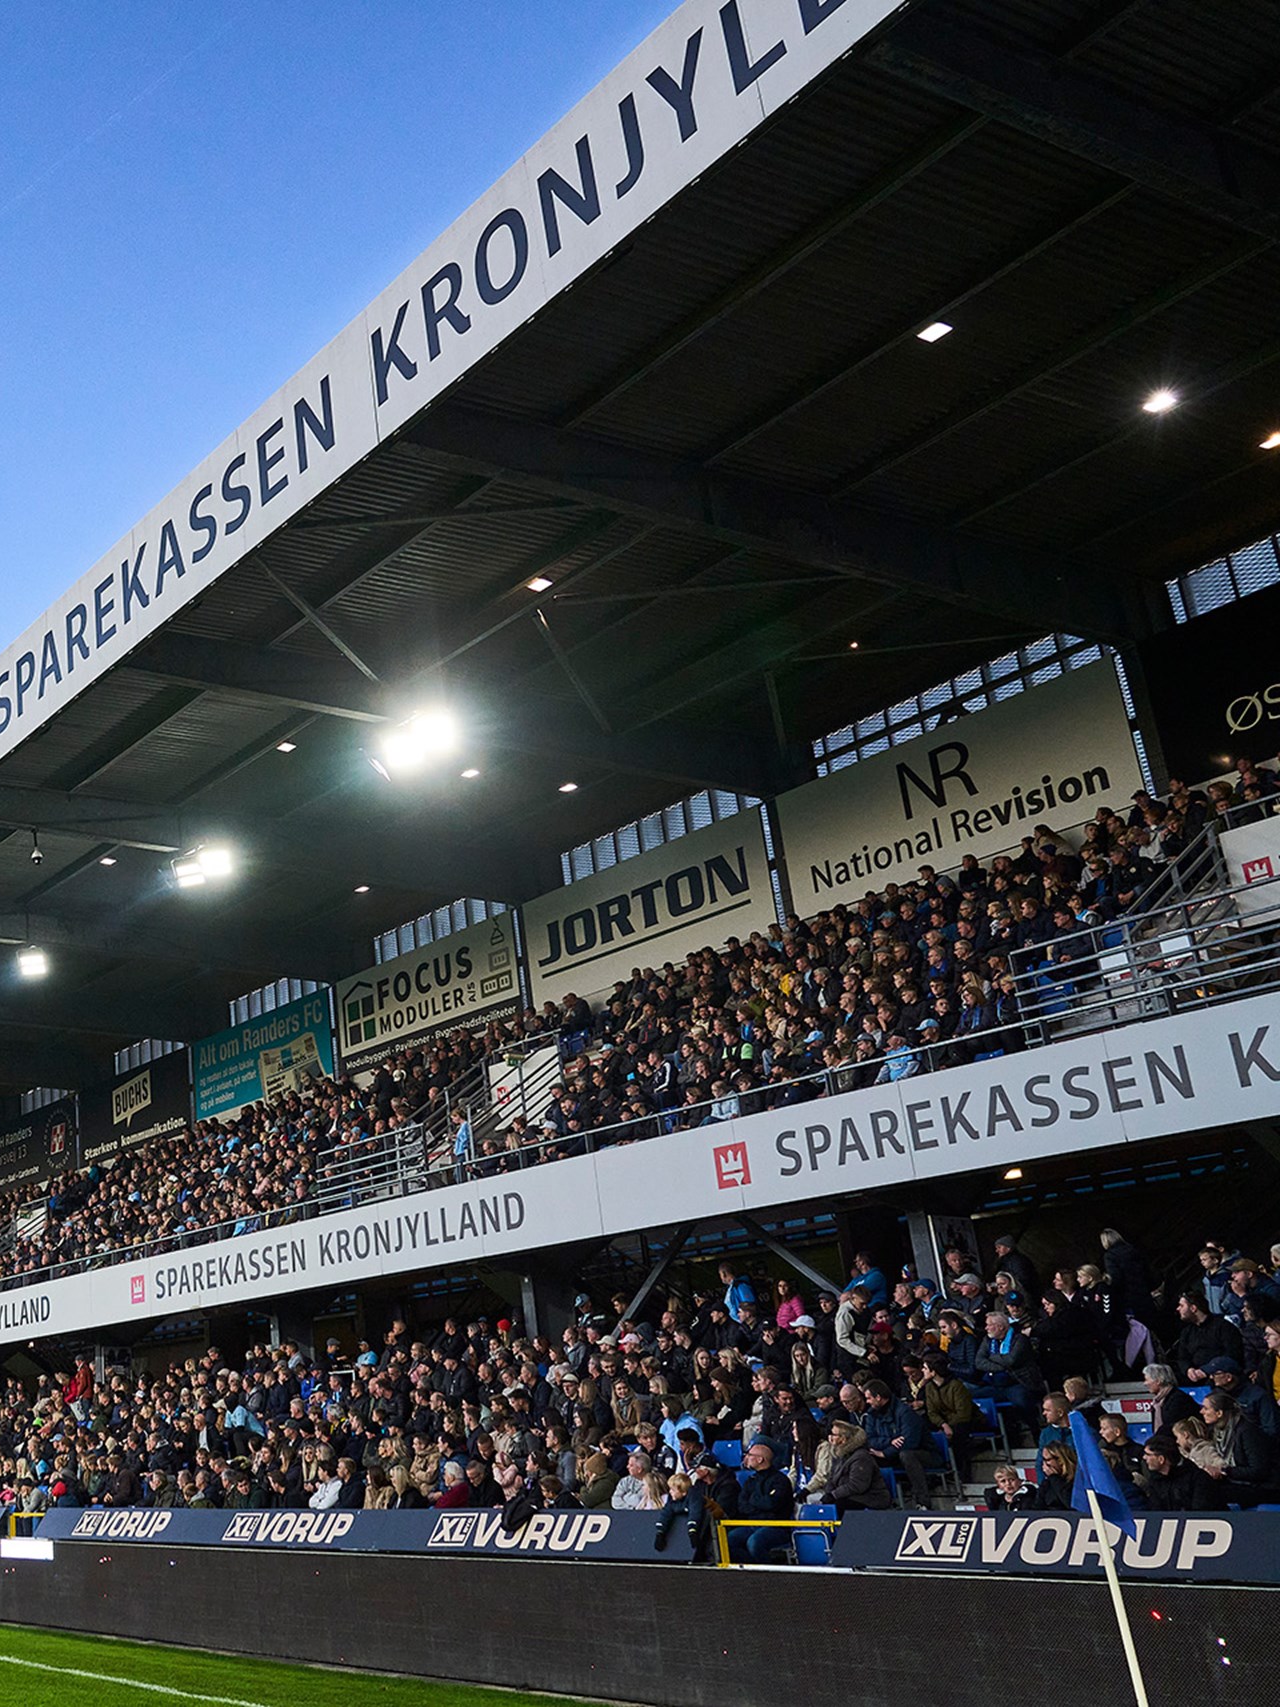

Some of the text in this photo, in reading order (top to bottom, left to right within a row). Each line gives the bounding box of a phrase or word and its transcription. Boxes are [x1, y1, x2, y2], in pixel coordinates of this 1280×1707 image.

[896, 740, 980, 821] NR
[809, 763, 1112, 894] National Revision
[537, 845, 752, 969] JORTON
[377, 946, 473, 1010] FOCUS
[200, 999, 323, 1069] Alt om Randers FC
[379, 988, 465, 1035] MODULER
[115, 1077, 149, 1117] BUCHS
[775, 1045, 1196, 1177] SPAREKASSEN
[84, 1140, 118, 1160] Stærkere
[154, 1190, 526, 1300] SPAREKASSEN KRONJYLLAND
[75, 1514, 97, 1533] XL
[96, 1511, 172, 1538] VORUP
[225, 1515, 251, 1538] XL
[255, 1512, 355, 1544] VORUP
[432, 1517, 467, 1542] XL
[901, 1517, 1234, 1570] XL BYG VORUP
